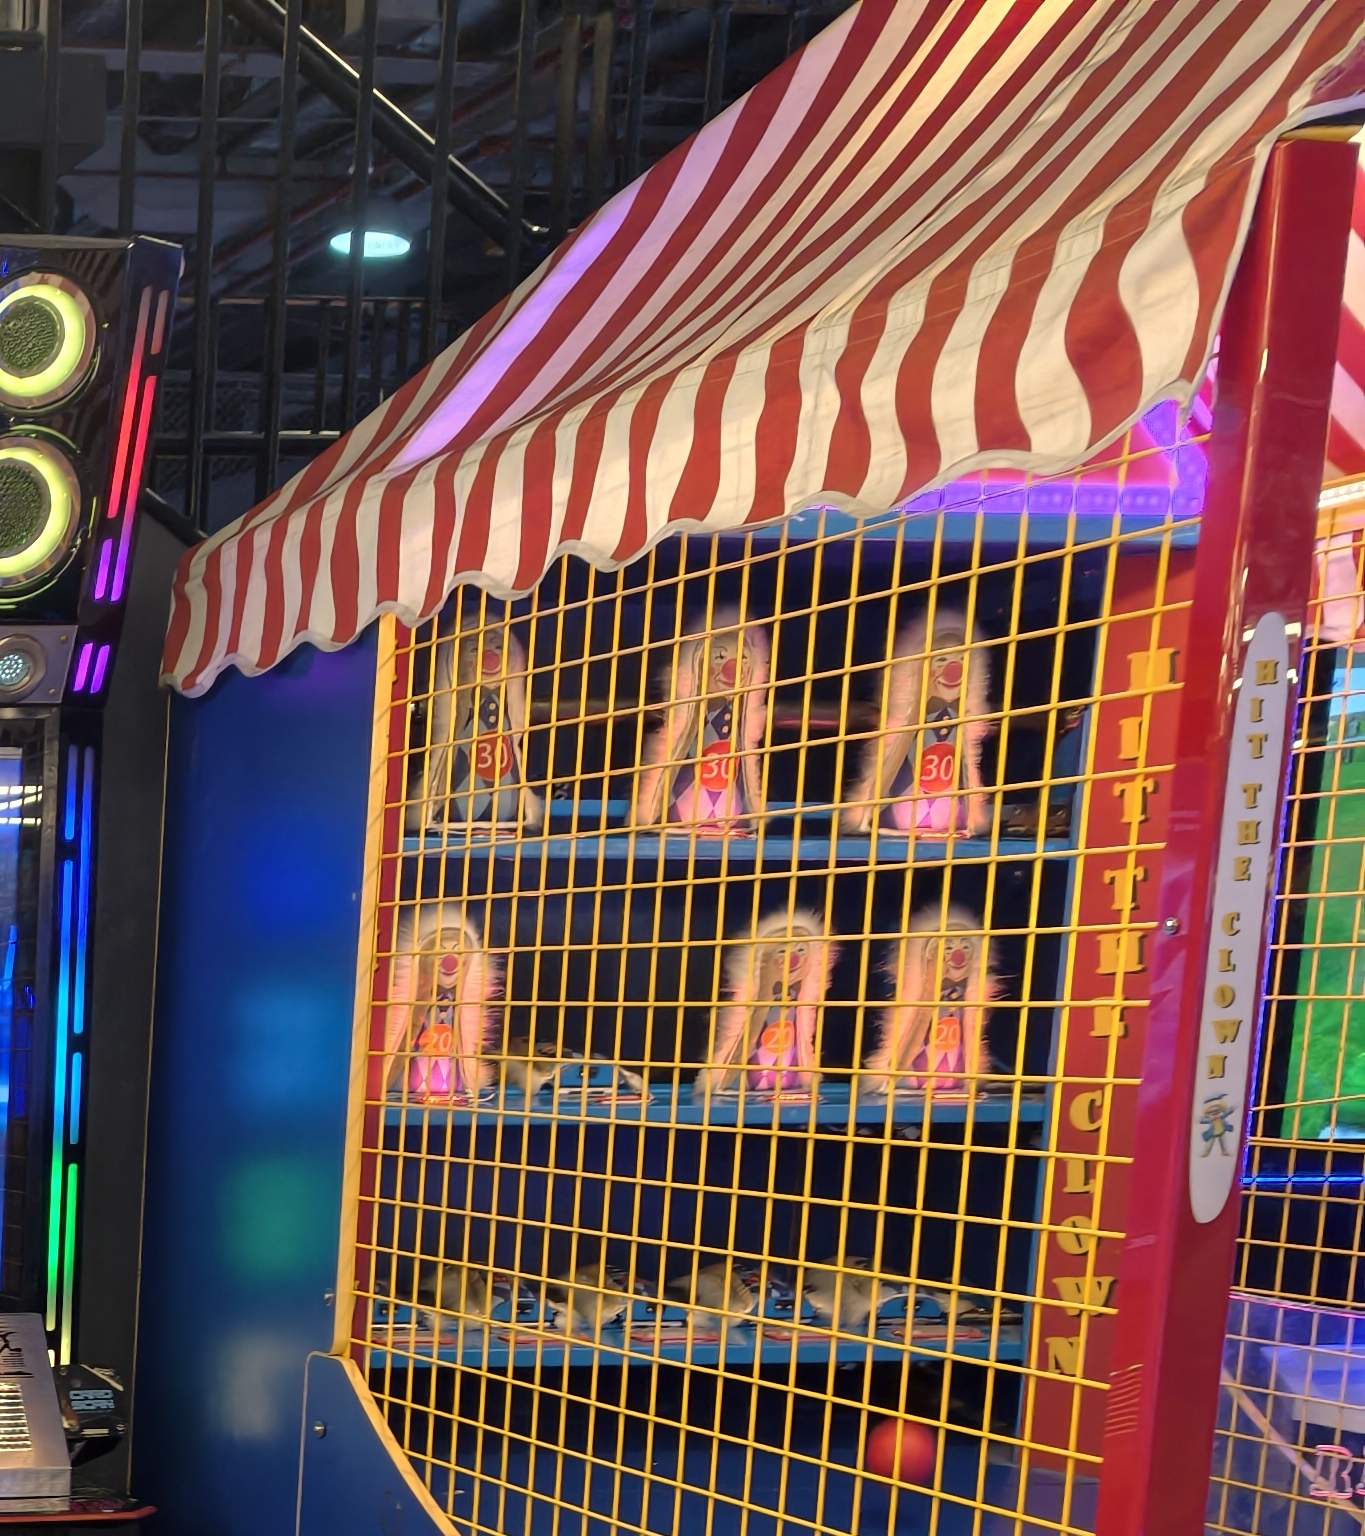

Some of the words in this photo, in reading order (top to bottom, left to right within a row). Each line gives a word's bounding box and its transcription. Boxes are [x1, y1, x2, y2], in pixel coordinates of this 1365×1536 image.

[1246, 659, 1279, 761] HIT
[920, 754, 955, 781] 30
[1234, 781, 1263, 882] THE
[936, 1023, 961, 1045] 20
[1206, 911, 1242, 1080] CLOWN
